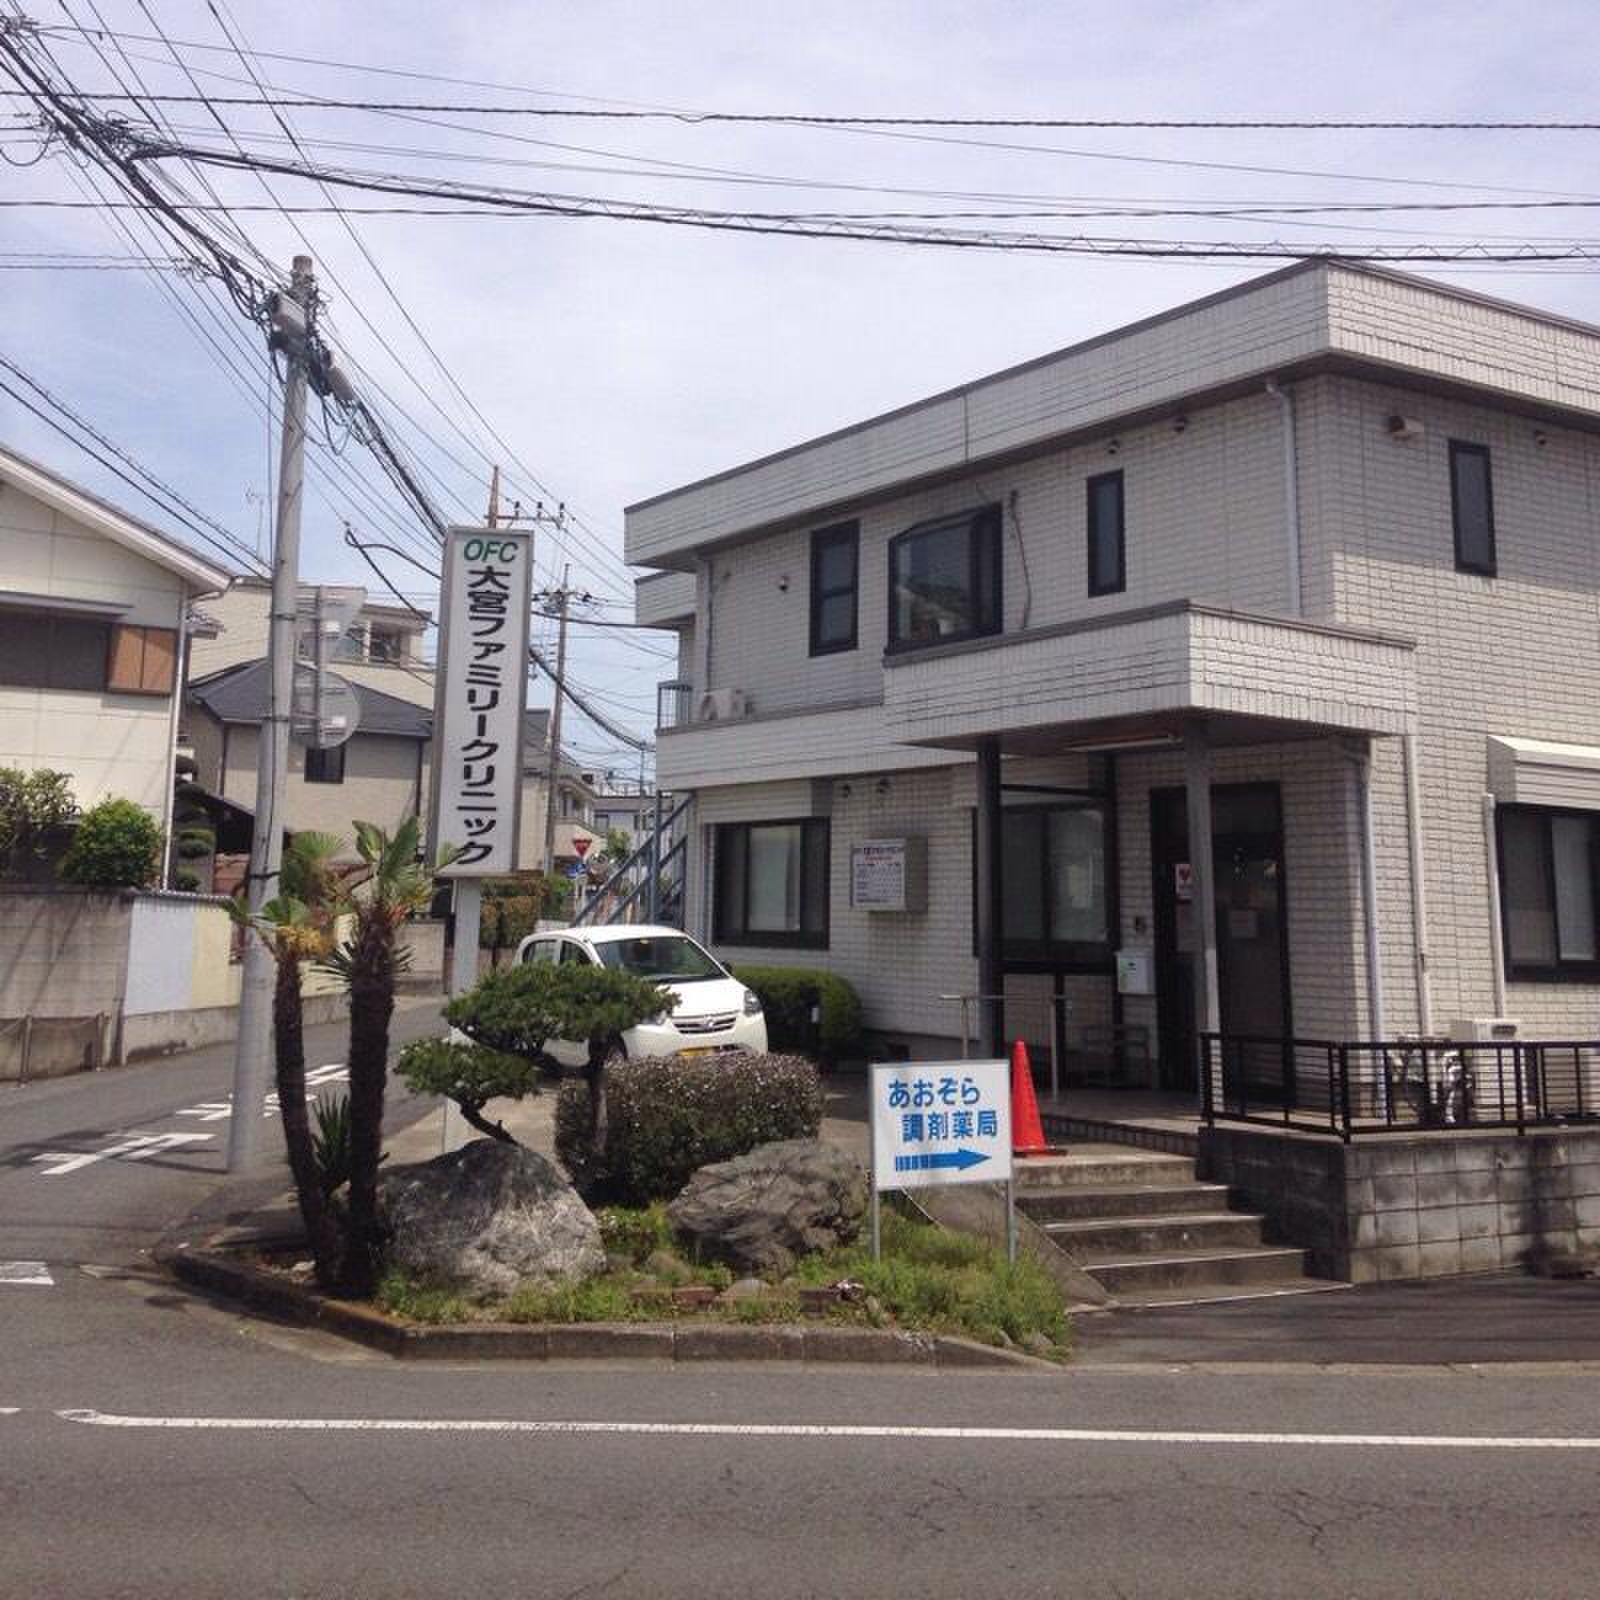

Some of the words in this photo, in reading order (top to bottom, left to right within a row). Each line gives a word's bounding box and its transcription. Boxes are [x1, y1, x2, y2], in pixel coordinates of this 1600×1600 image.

[463, 538, 519, 563] OFC
[456, 565, 511, 865] 大宮ファミリークリニック
[888, 1077, 981, 1108] あおぞら
[901, 1110, 998, 1142] 調剤薬局
